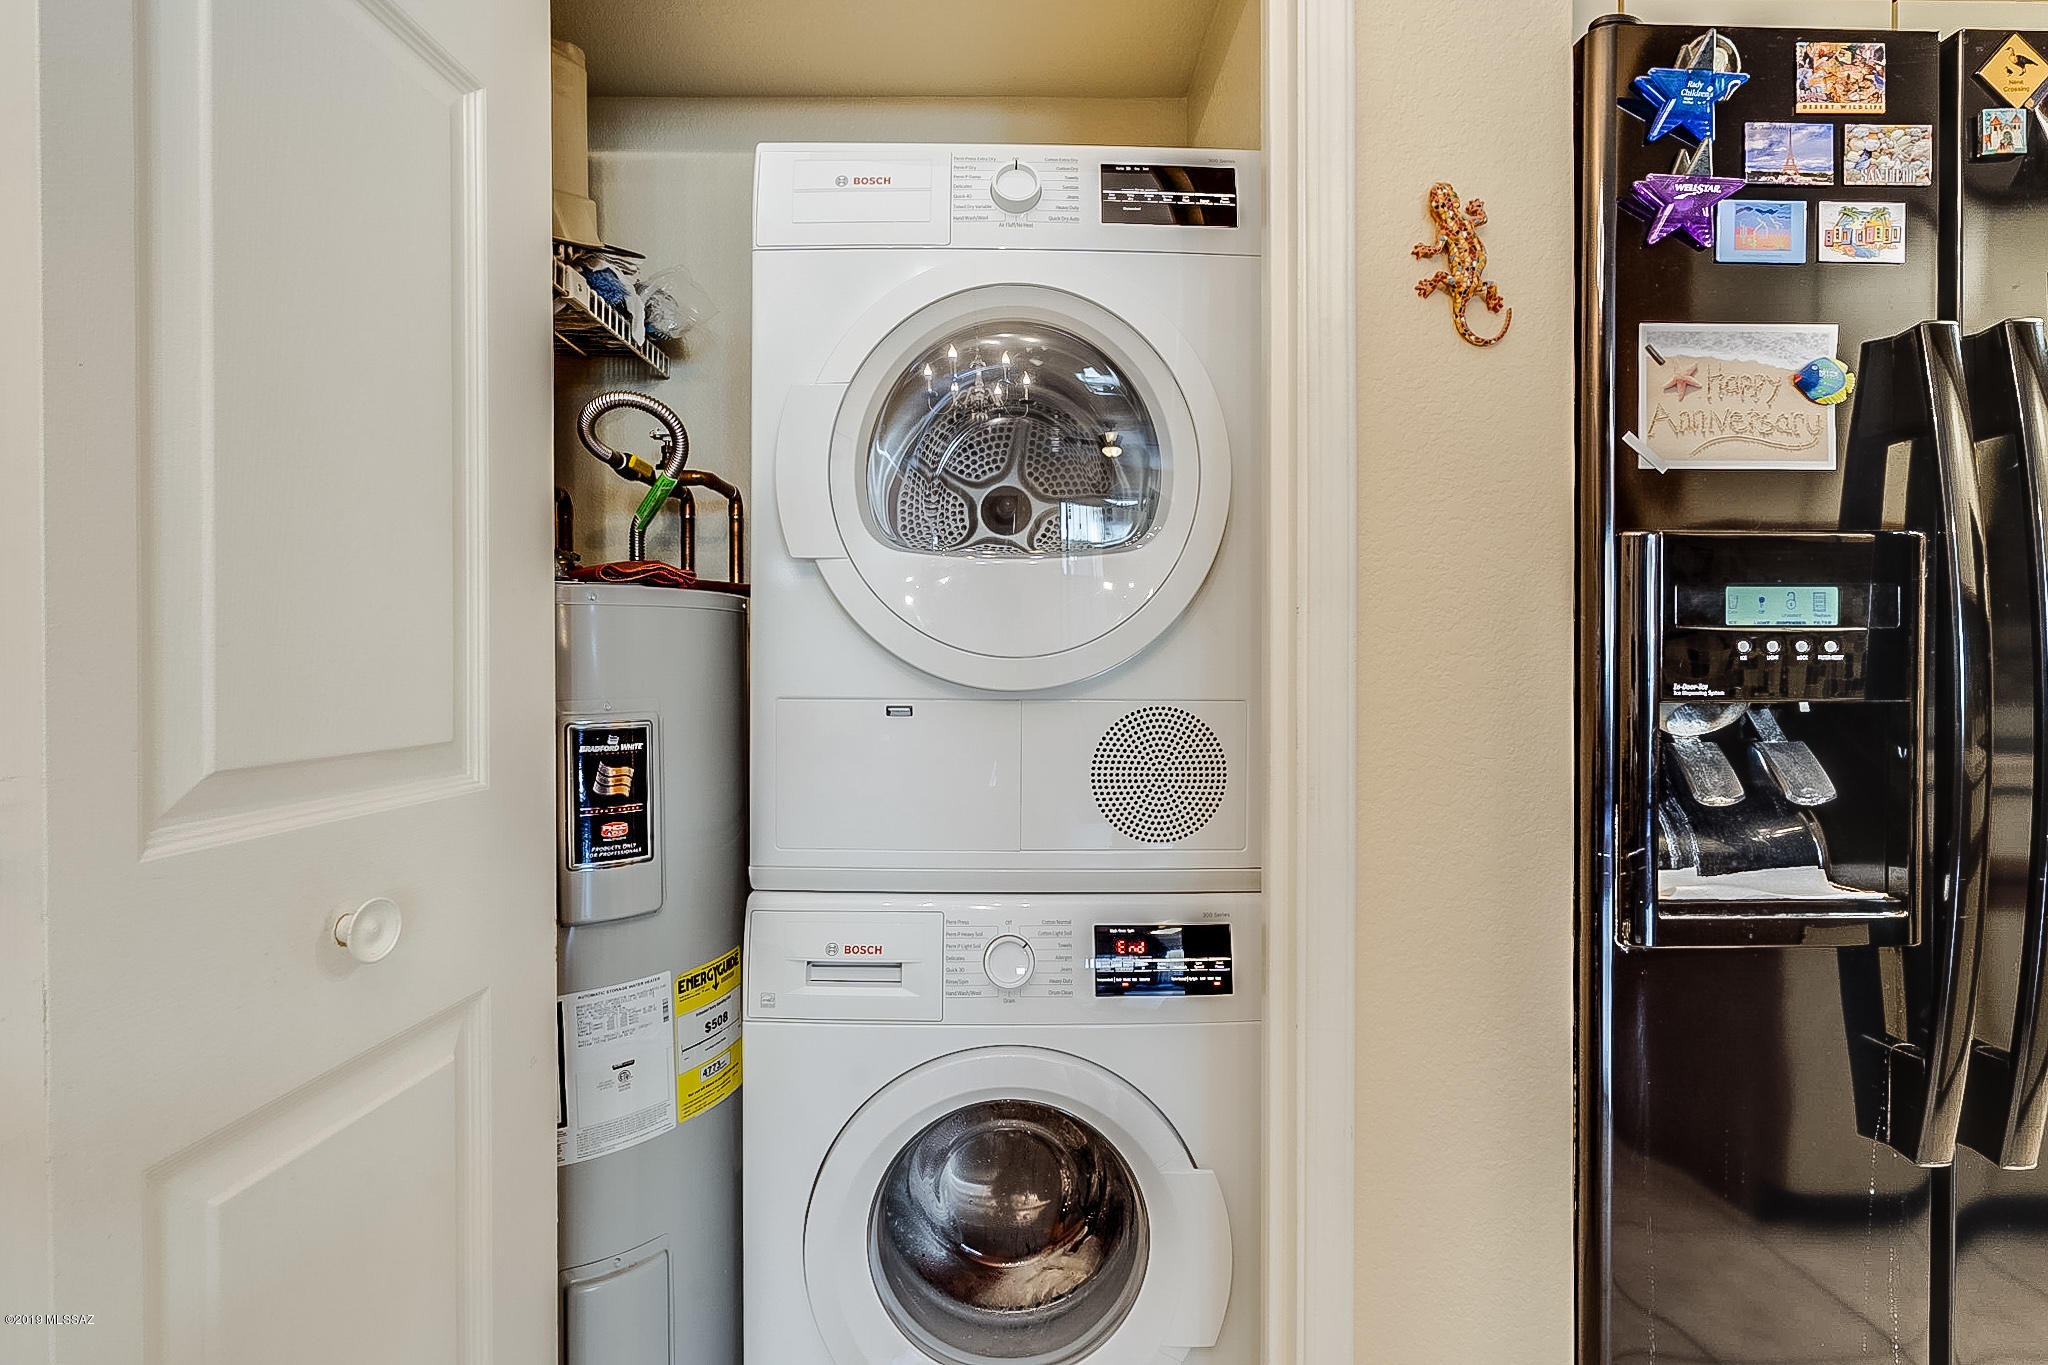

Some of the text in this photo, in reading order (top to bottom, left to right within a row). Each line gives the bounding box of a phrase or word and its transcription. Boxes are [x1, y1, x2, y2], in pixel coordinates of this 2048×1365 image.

[1687, 81, 1704, 91] Rady
[853, 176, 892, 185] BOSCH
[1706, 363, 1783, 409] Happy
[1647, 402, 1825, 440] Anniversary
[579, 742, 644, 753] BRADFORD WHITE
[591, 842, 637, 852] PRODUCTS ONLY
[844, 945, 883, 955] BOSCH
[1116, 940, 1145, 954] End
[678, 951, 740, 994] ENERGYGUIDE
[704, 1011, 729, 1034] $508
